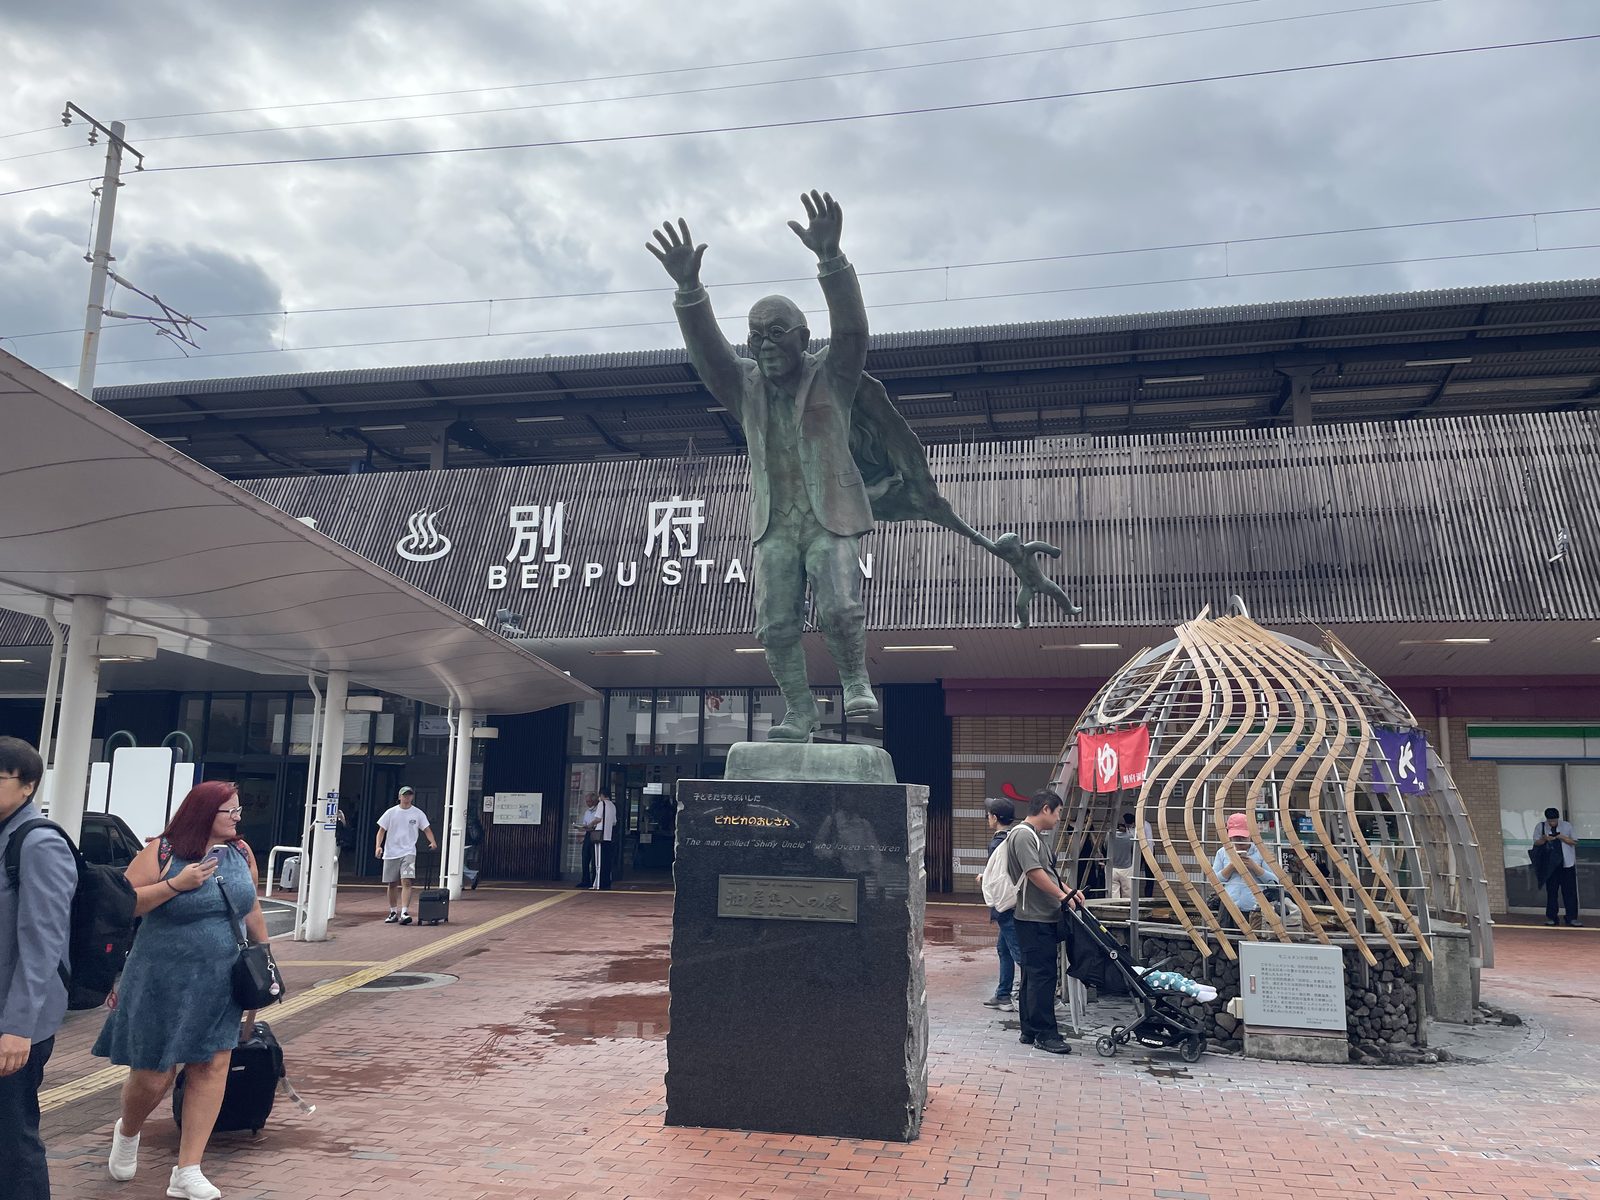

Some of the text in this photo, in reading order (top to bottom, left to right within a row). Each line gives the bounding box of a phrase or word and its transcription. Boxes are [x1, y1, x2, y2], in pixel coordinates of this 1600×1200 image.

[487, 554, 873, 590] BEPPU STAN
[1097, 742, 1118, 784] ゆ
[714, 815, 790, 827] ピカピカのおじさん
[685, 837, 701, 846] The
[723, 839, 750, 847] called
[814, 842, 832, 850] who
[834, 841, 860, 851] loved
